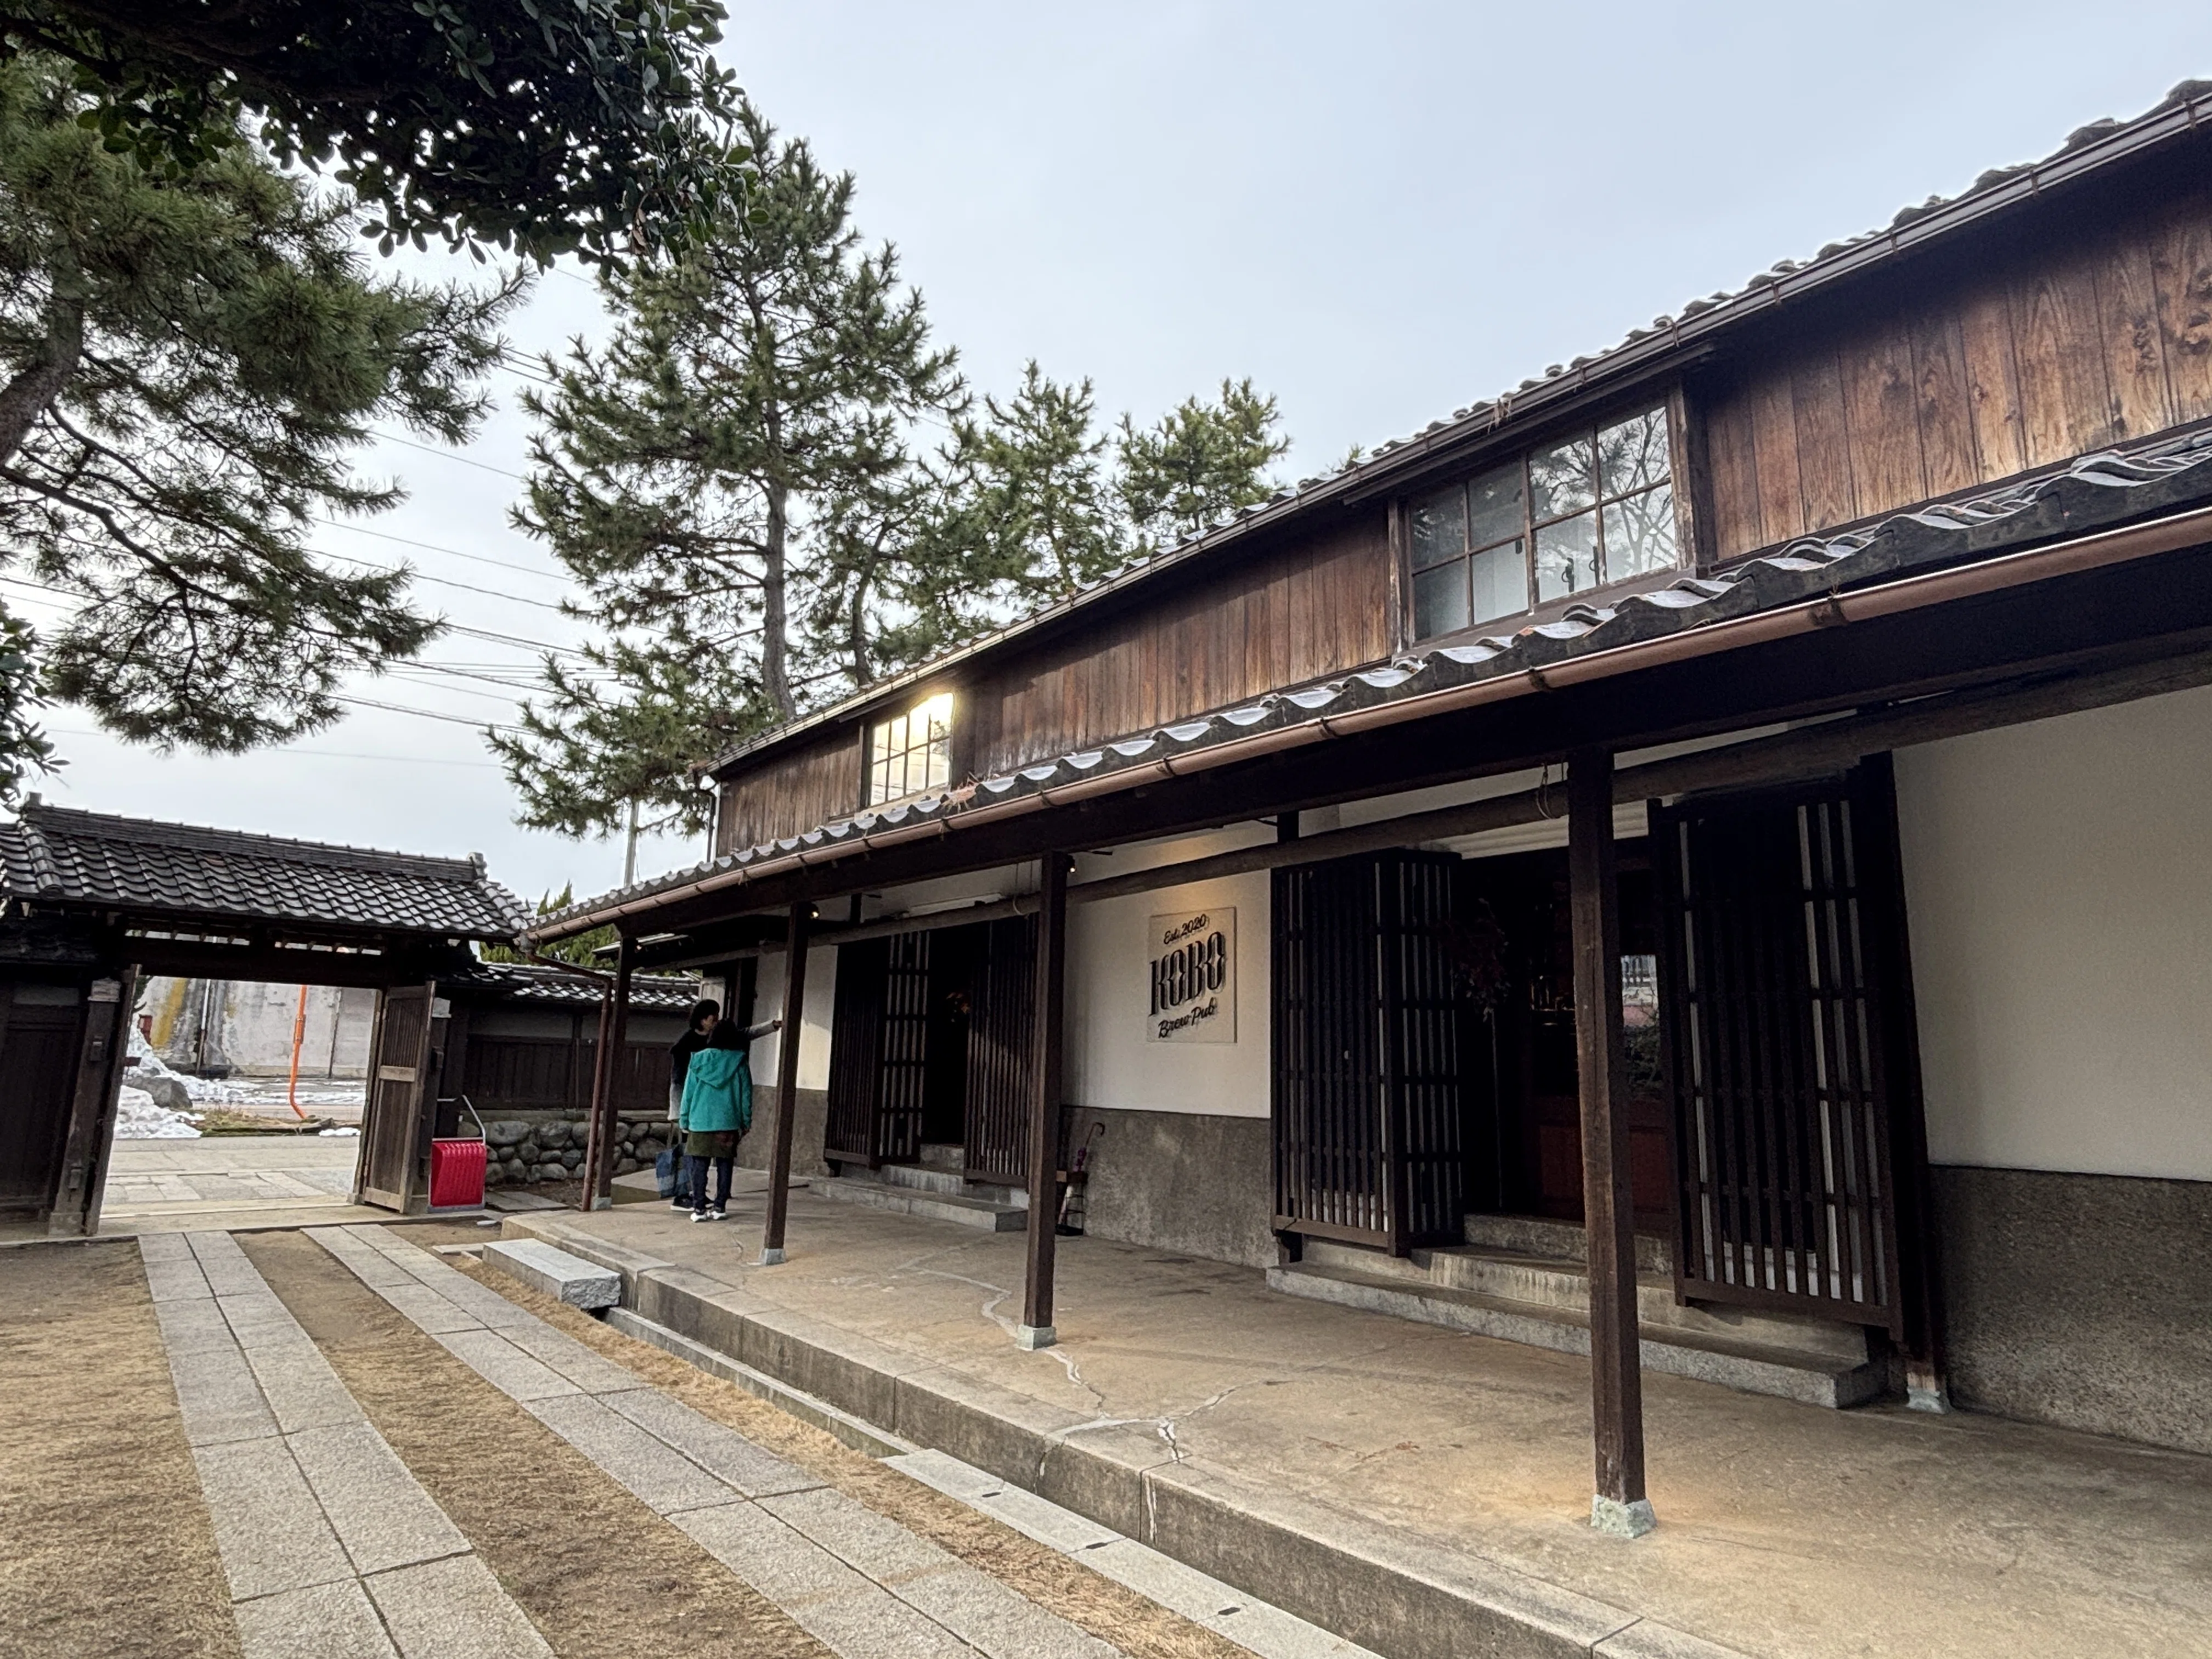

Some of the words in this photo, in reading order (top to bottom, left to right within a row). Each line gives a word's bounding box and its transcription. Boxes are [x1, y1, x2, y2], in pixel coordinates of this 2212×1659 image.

[1182, 913, 1206, 935] 2020
[1149, 931, 1225, 1017] KOBO
[1158, 1014, 1191, 1039] Brew
[1191, 997, 1216, 1026] Pub
